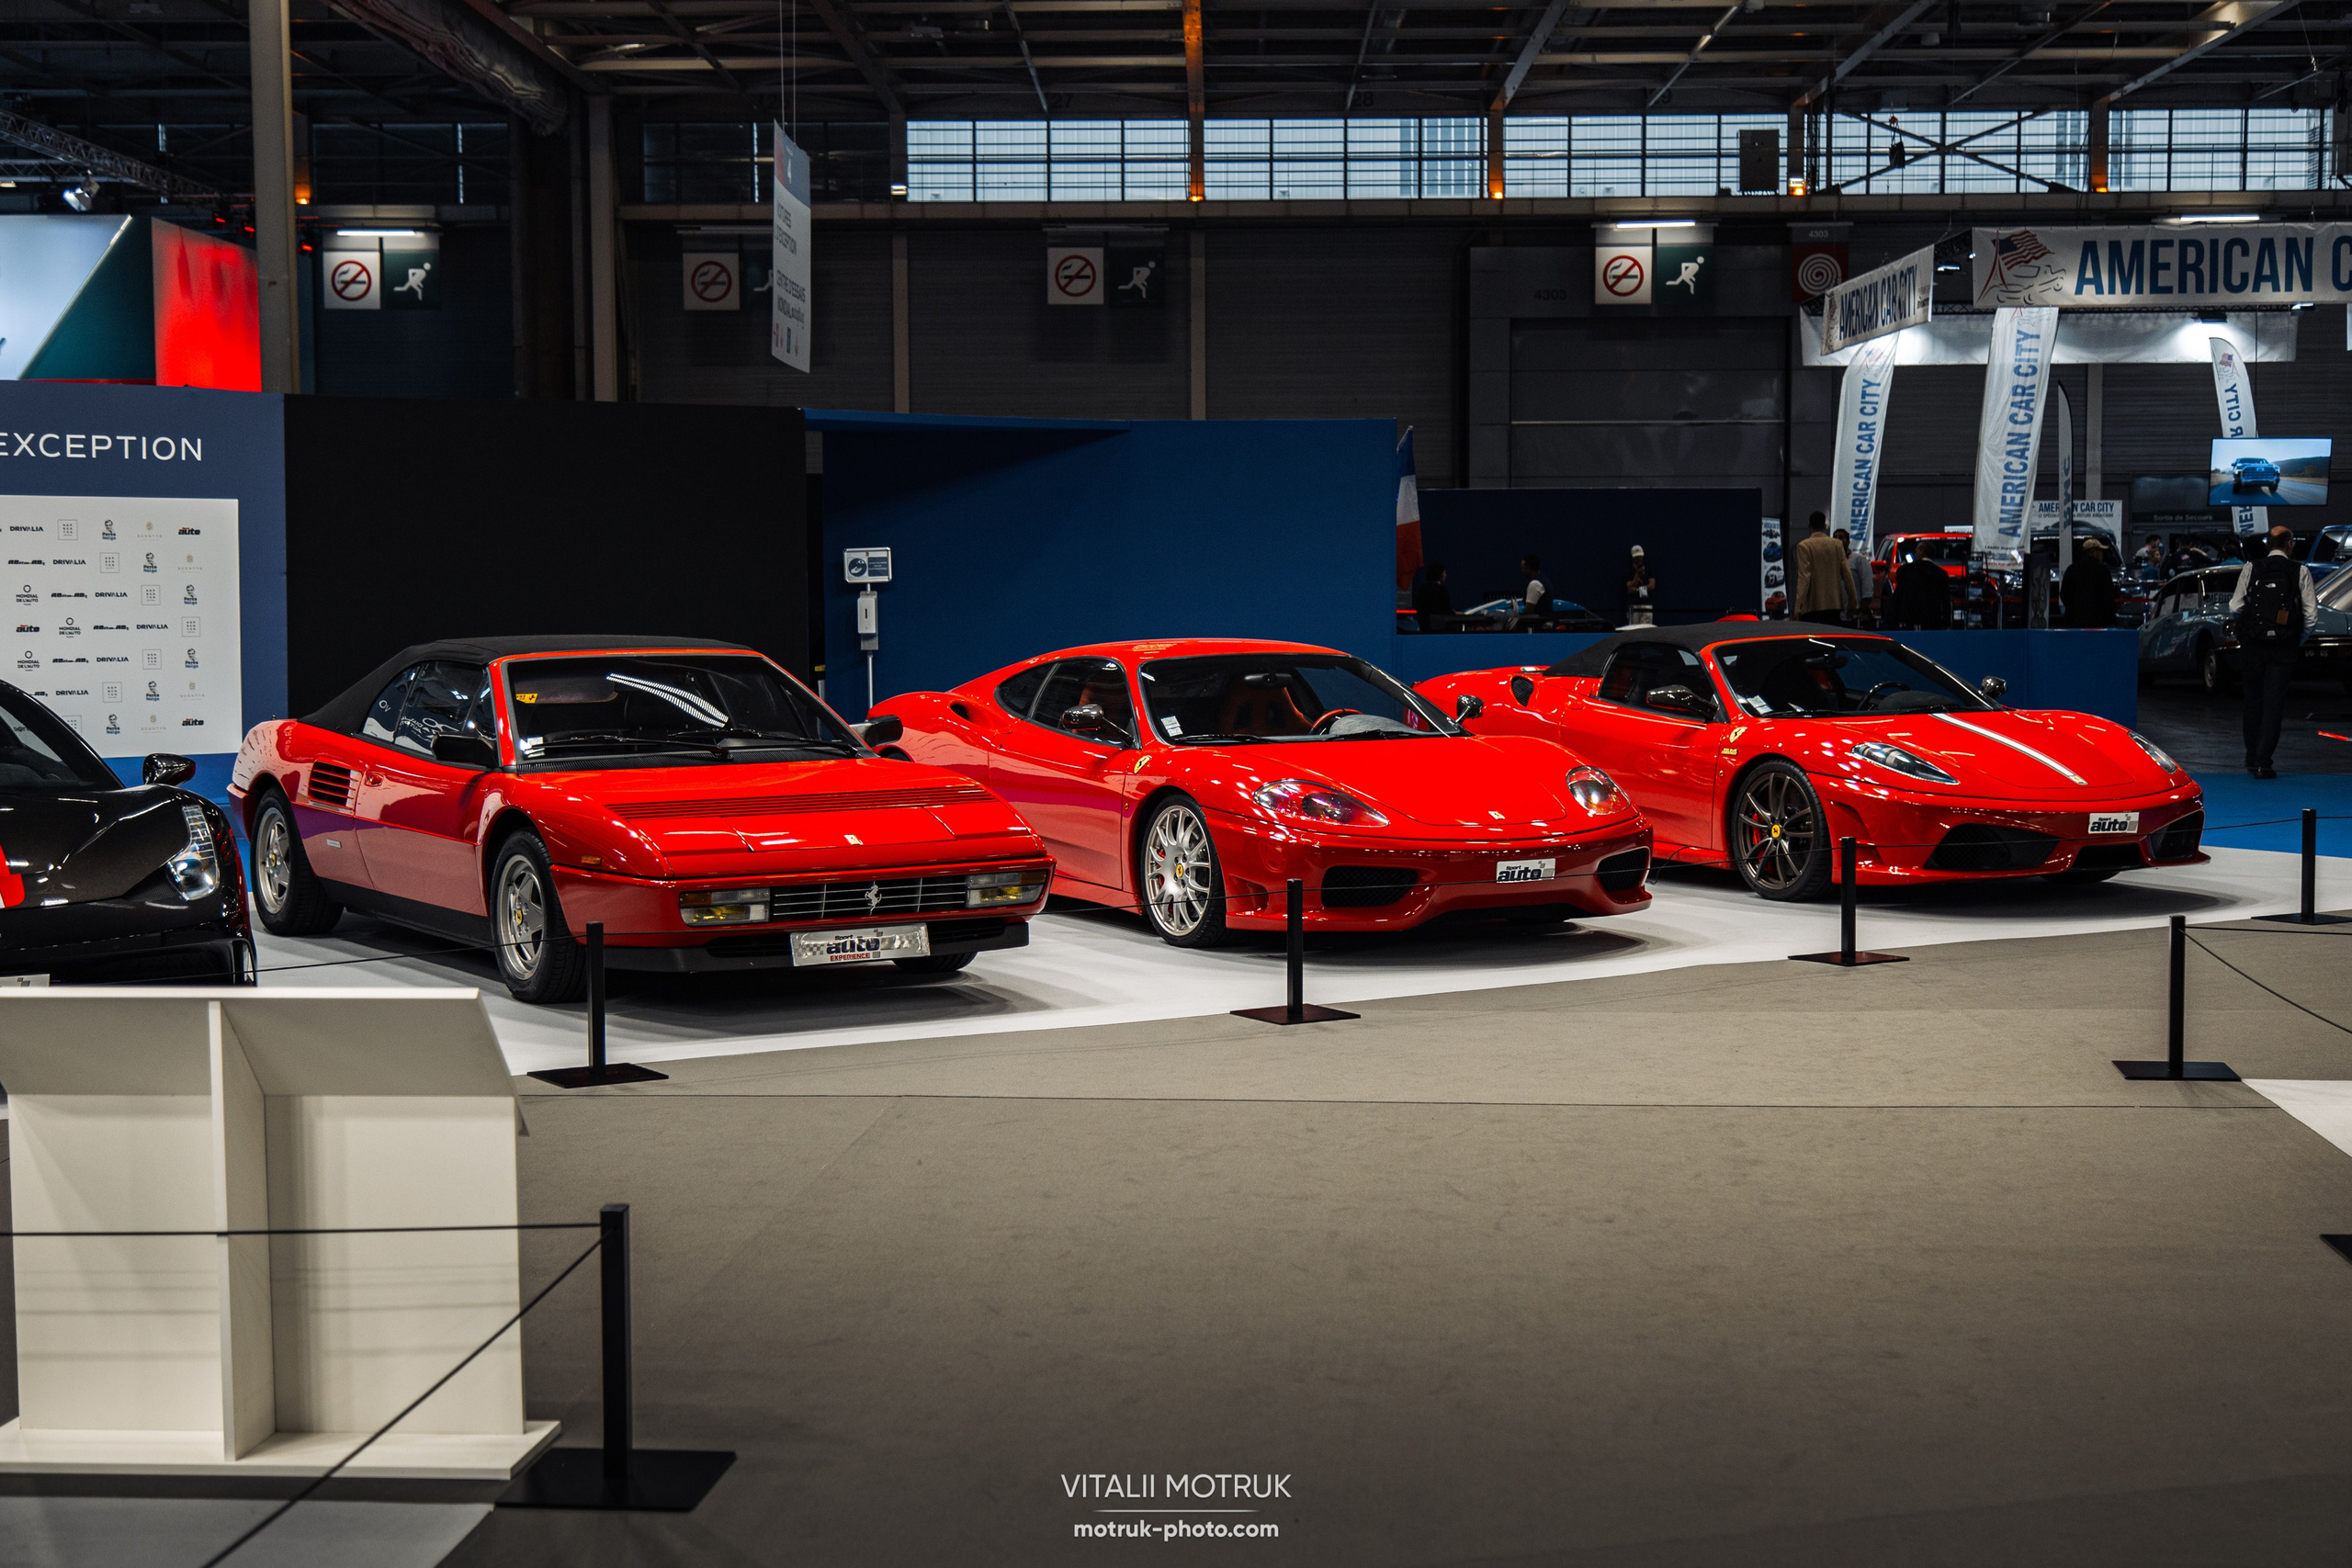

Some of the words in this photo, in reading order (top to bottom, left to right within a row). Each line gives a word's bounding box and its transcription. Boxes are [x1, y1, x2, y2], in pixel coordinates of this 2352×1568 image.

[1808, 230, 1828, 238] 4303
[2075, 237, 2314, 296] AMERICAN
[2332, 235, 2352, 292] C
[1534, 289, 1566, 301] 4303
[1839, 281, 1878, 341] AMERICAN
[1881, 273, 1896, 327] CAR
[1898, 265, 1917, 321] CITY
[2014, 330, 2041, 378] CITY
[1860, 378, 1882, 419] CITY
[2008, 384, 2036, 425] CAR
[1856, 421, 1876, 455] CAR
[1849, 458, 1872, 542] AMERICAN
[1997, 432, 2031, 538] AMERICAN
[2038, 502, 2078, 513] AMERN
[2080, 502, 2096, 513] CAR
[2098, 502, 2115, 513] CITY
[2090, 818, 2128, 831] auto
[1498, 867, 1542, 882] auto
[827, 936, 880, 954] auto
[830, 953, 870, 962] EXPERIENCE
